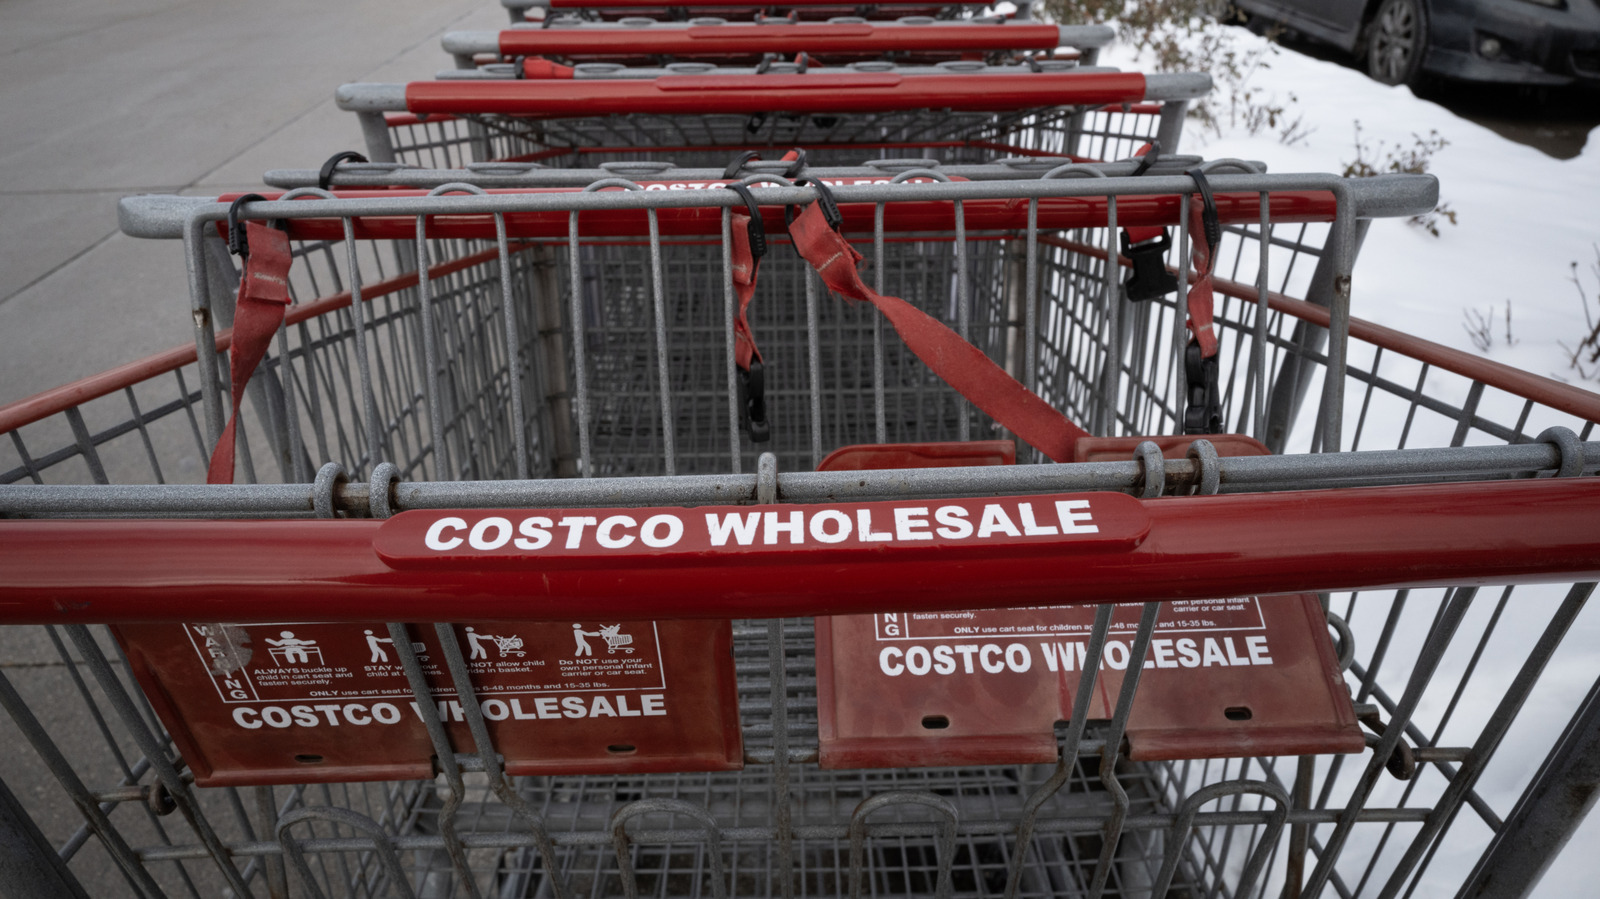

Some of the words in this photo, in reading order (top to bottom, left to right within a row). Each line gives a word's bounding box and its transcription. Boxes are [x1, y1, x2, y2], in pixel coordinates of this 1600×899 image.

[424, 515, 684, 550] COSTCO
[704, 499, 1099, 546] WHOLESALE
[940, 612, 977, 620] securely.
[954, 626, 979, 634] ONLY
[1159, 620, 1174, 628] and
[879, 643, 1032, 677] COSTCO
[1040, 636, 1274, 672] WOESALE
[582, 663, 624, 671] personal
[290, 678, 333, 686] securely.
[232, 702, 401, 729] COSTCO
